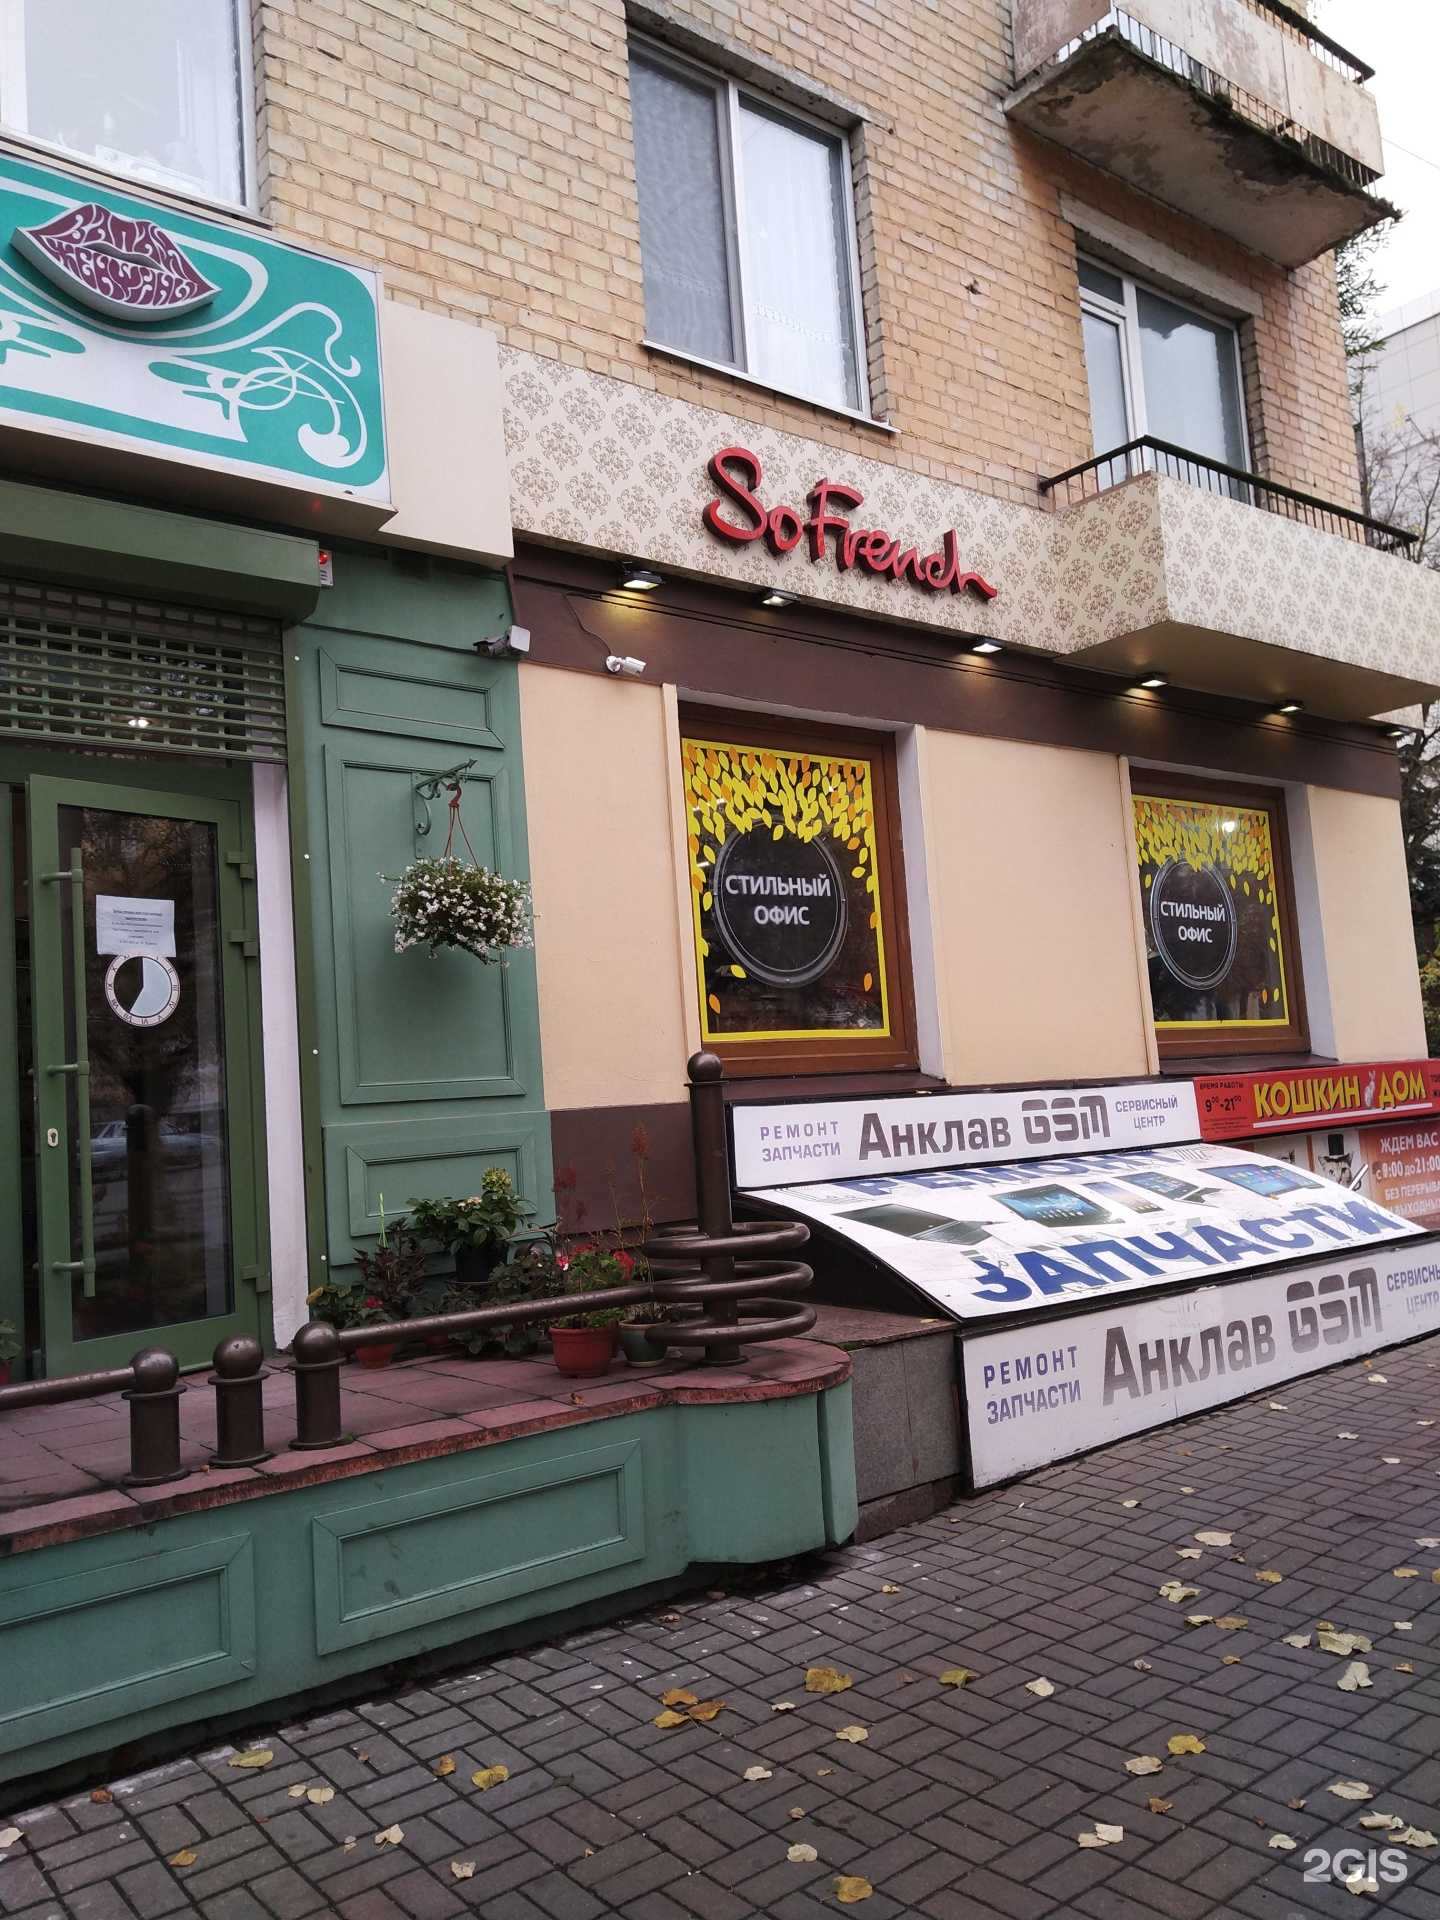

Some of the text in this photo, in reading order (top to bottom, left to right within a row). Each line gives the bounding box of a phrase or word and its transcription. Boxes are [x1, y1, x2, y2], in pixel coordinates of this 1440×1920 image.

[725, 873, 832, 897] СТИЛЬНЫЙ
[753, 905, 811, 925] ОФИС
[1160, 901, 1226, 922] СТИЛЬНЫЙ
[1178, 925, 1213, 943] ОФИС
[1115, 1094, 1178, 1113] СЕРВИСНЫЙ
[1253, 1070, 1427, 1120] КОШКИН ДОМ
[760, 1121, 838, 1140] РЕМОНТ
[859, 1095, 1111, 1160] Анклав GSM
[1133, 1115, 1165, 1130] ЦЕНТР
[762, 1142, 841, 1162] ЗАПЧАСТИ
[1380, 1131, 1439, 1156] ЖДЕМ ВАС
[1414, 1154, 1440, 1175] 21:00
[970, 1200, 1406, 1303] ЗАПЧАСТИ
[1102, 1267, 1384, 1406] Анклав GSM
[983, 1345, 1078, 1389] РЕМОНТ
[987, 1379, 1082, 1425] ЗАПЧАСТИ
